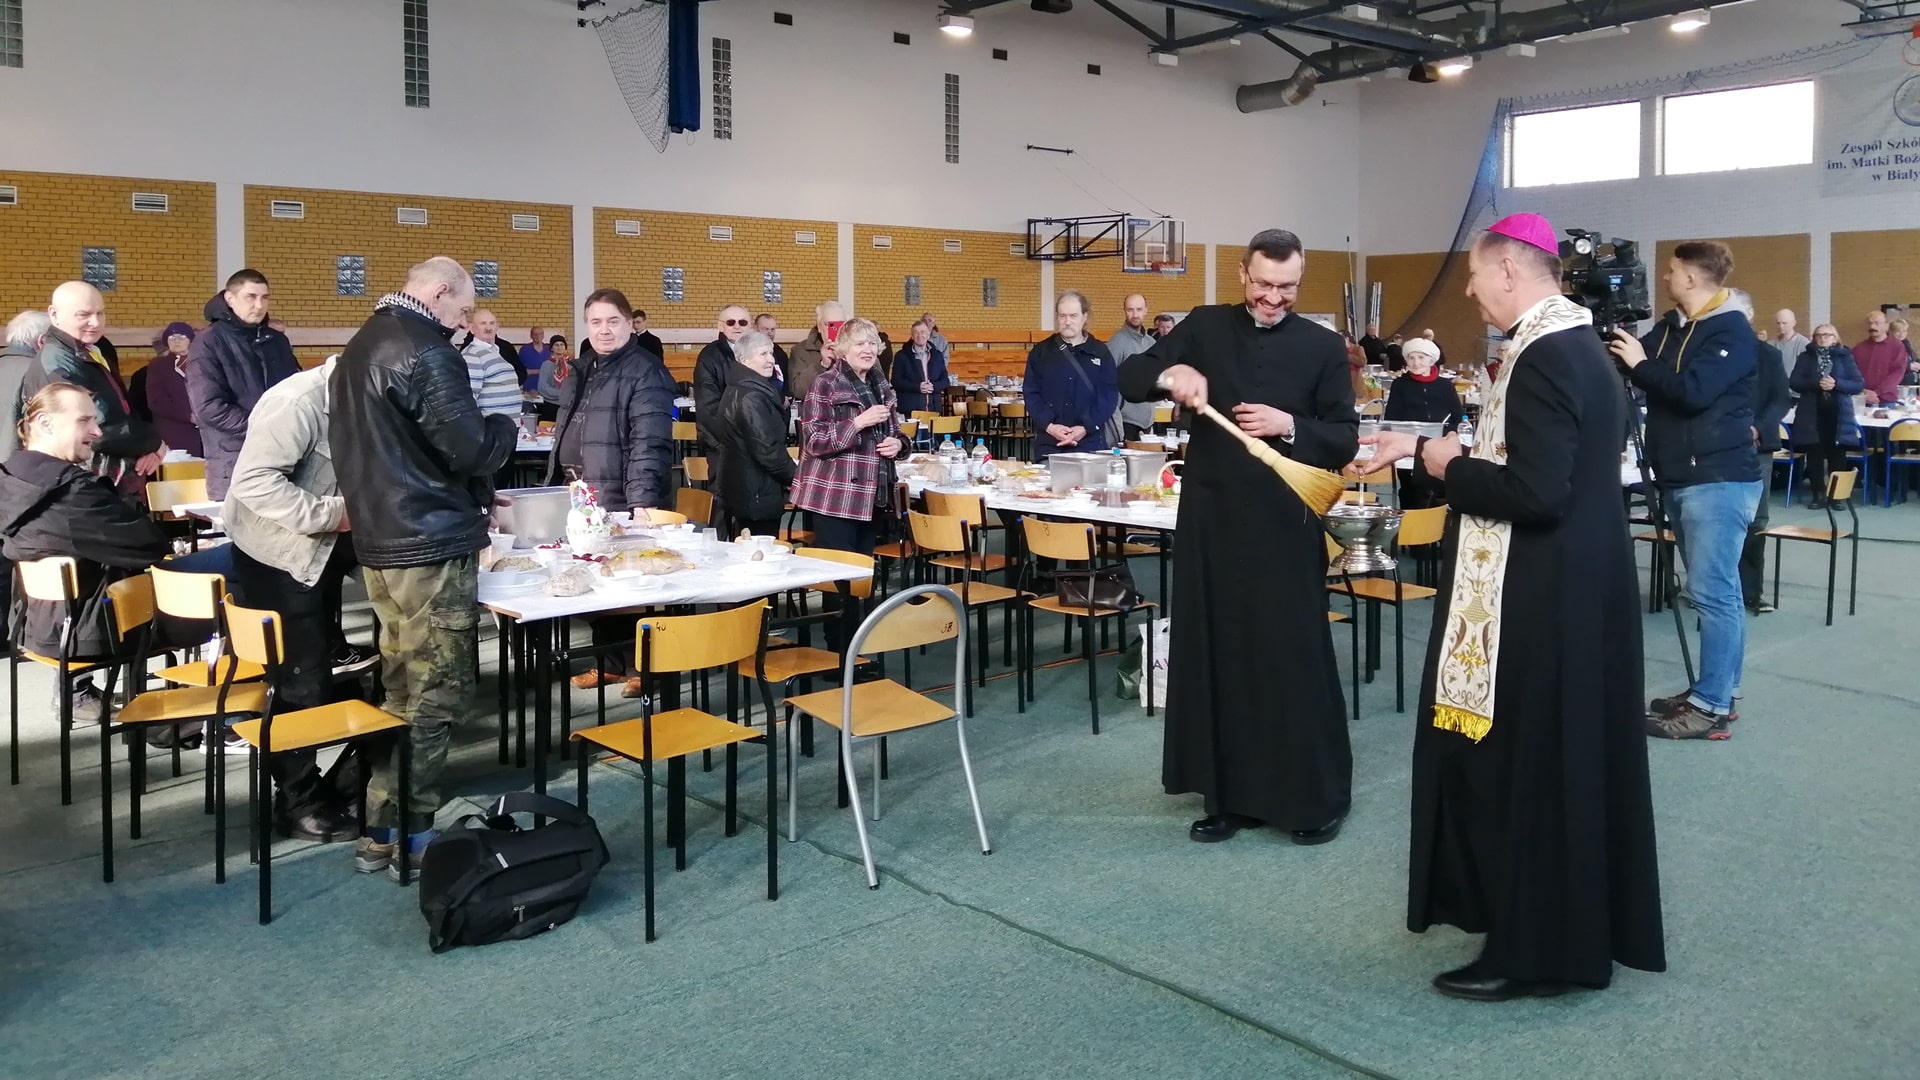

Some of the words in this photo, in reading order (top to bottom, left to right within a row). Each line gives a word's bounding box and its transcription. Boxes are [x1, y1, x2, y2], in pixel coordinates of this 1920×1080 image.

[1827, 160, 1847, 169] im.
[1851, 155, 1890, 168] Matki
[1894, 153, 1920, 165] Boż
[1042, 522, 1051, 537] 8
